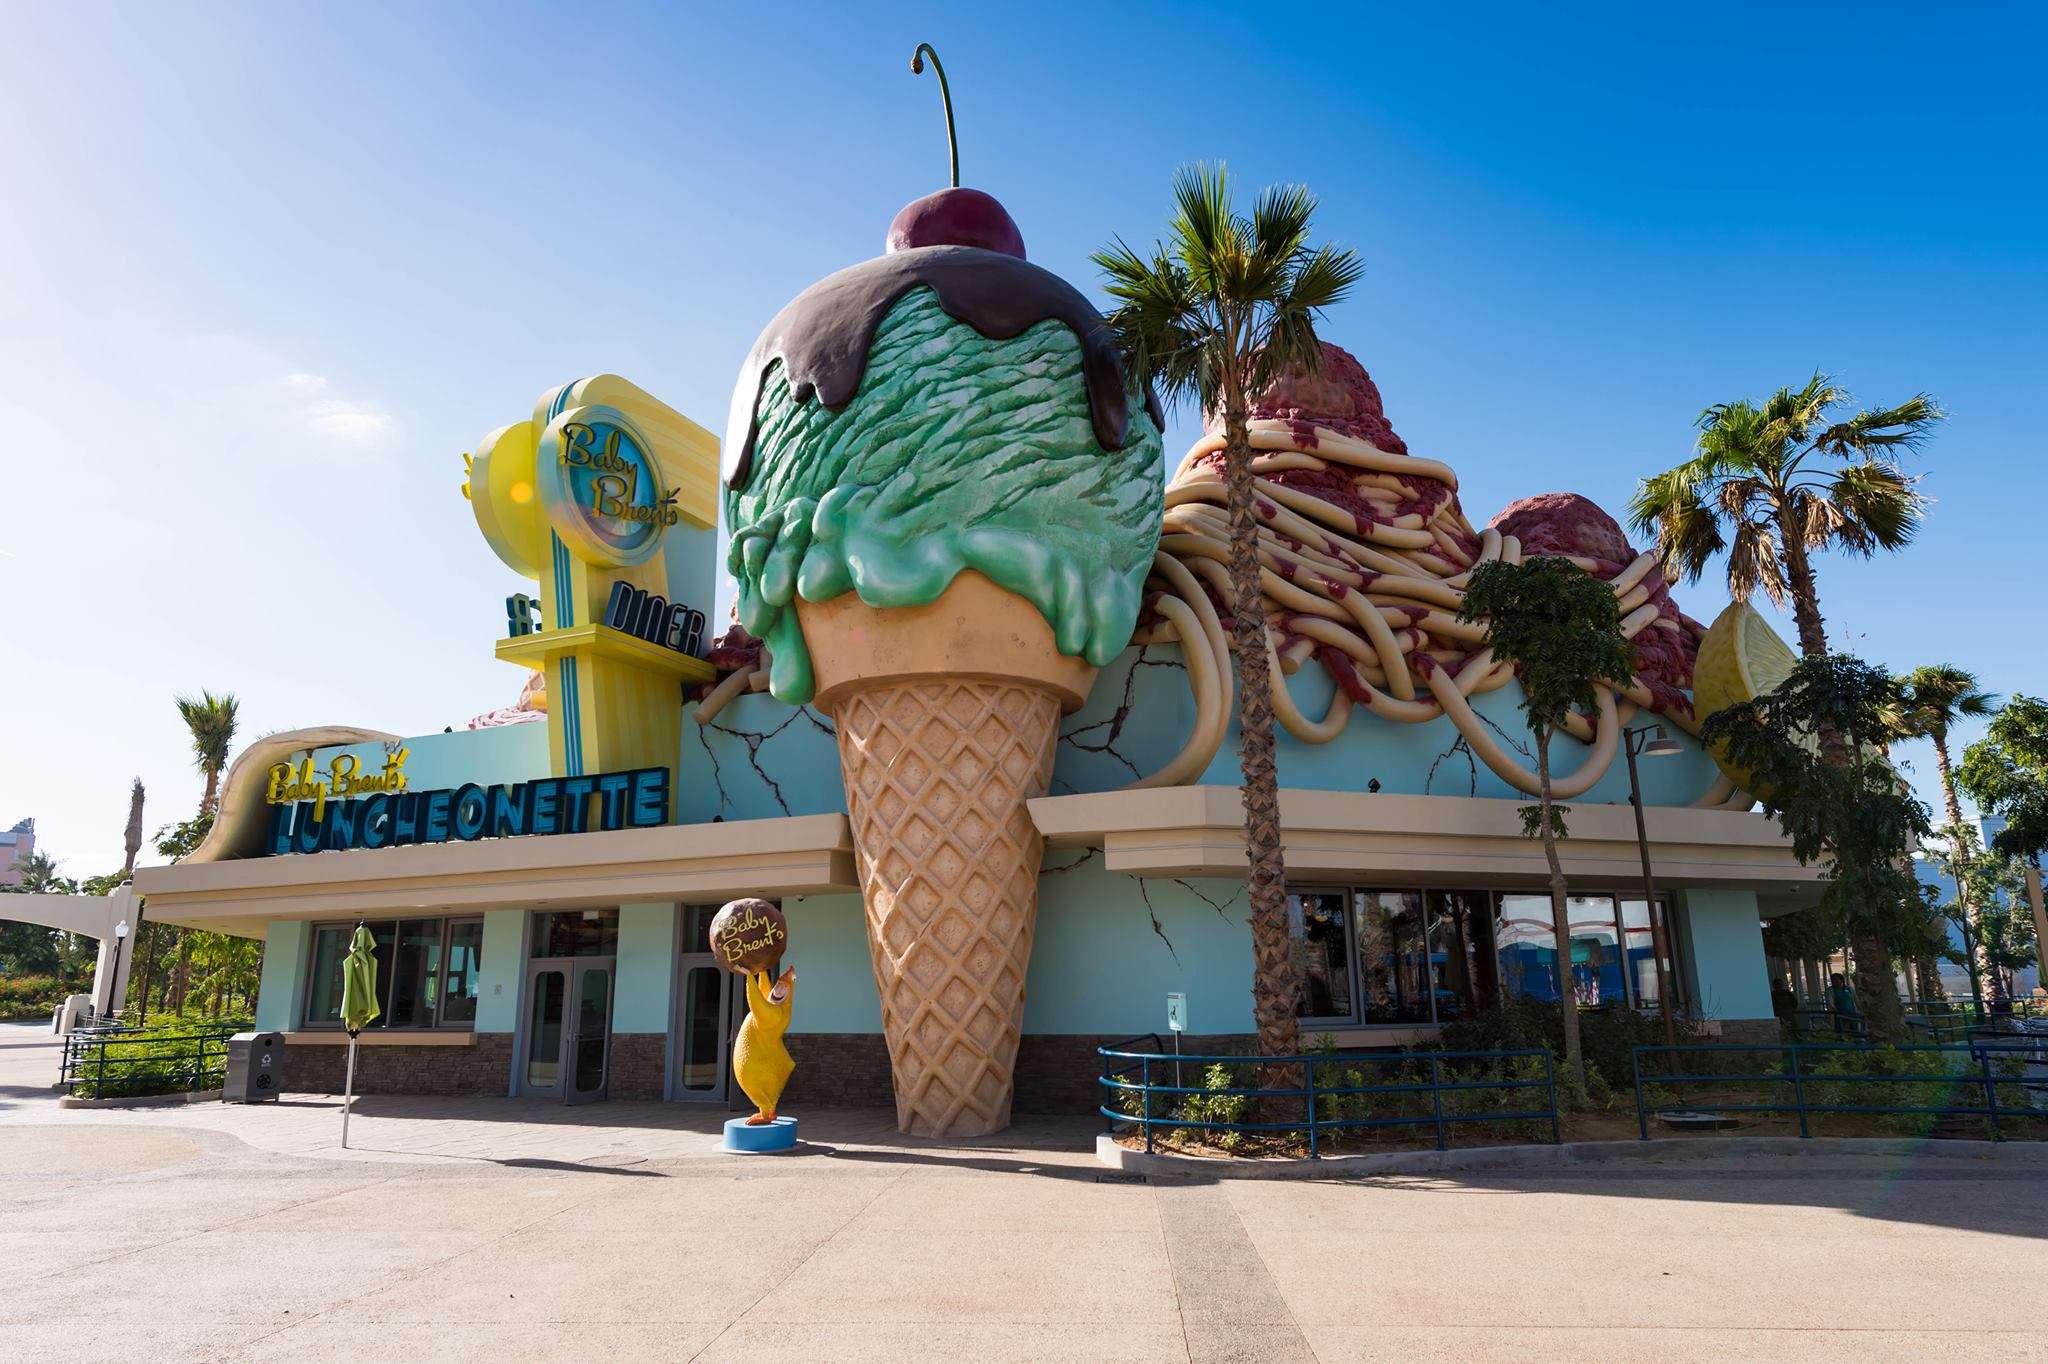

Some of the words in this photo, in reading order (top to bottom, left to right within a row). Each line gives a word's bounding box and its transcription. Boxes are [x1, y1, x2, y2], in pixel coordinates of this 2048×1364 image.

[559, 422, 638, 503] Baby
[607, 580, 706, 658] DINER
[265, 757, 326, 823] Baby
[266, 766, 670, 856] LUNCHEONETTE
[720, 907, 773, 946] Baby
